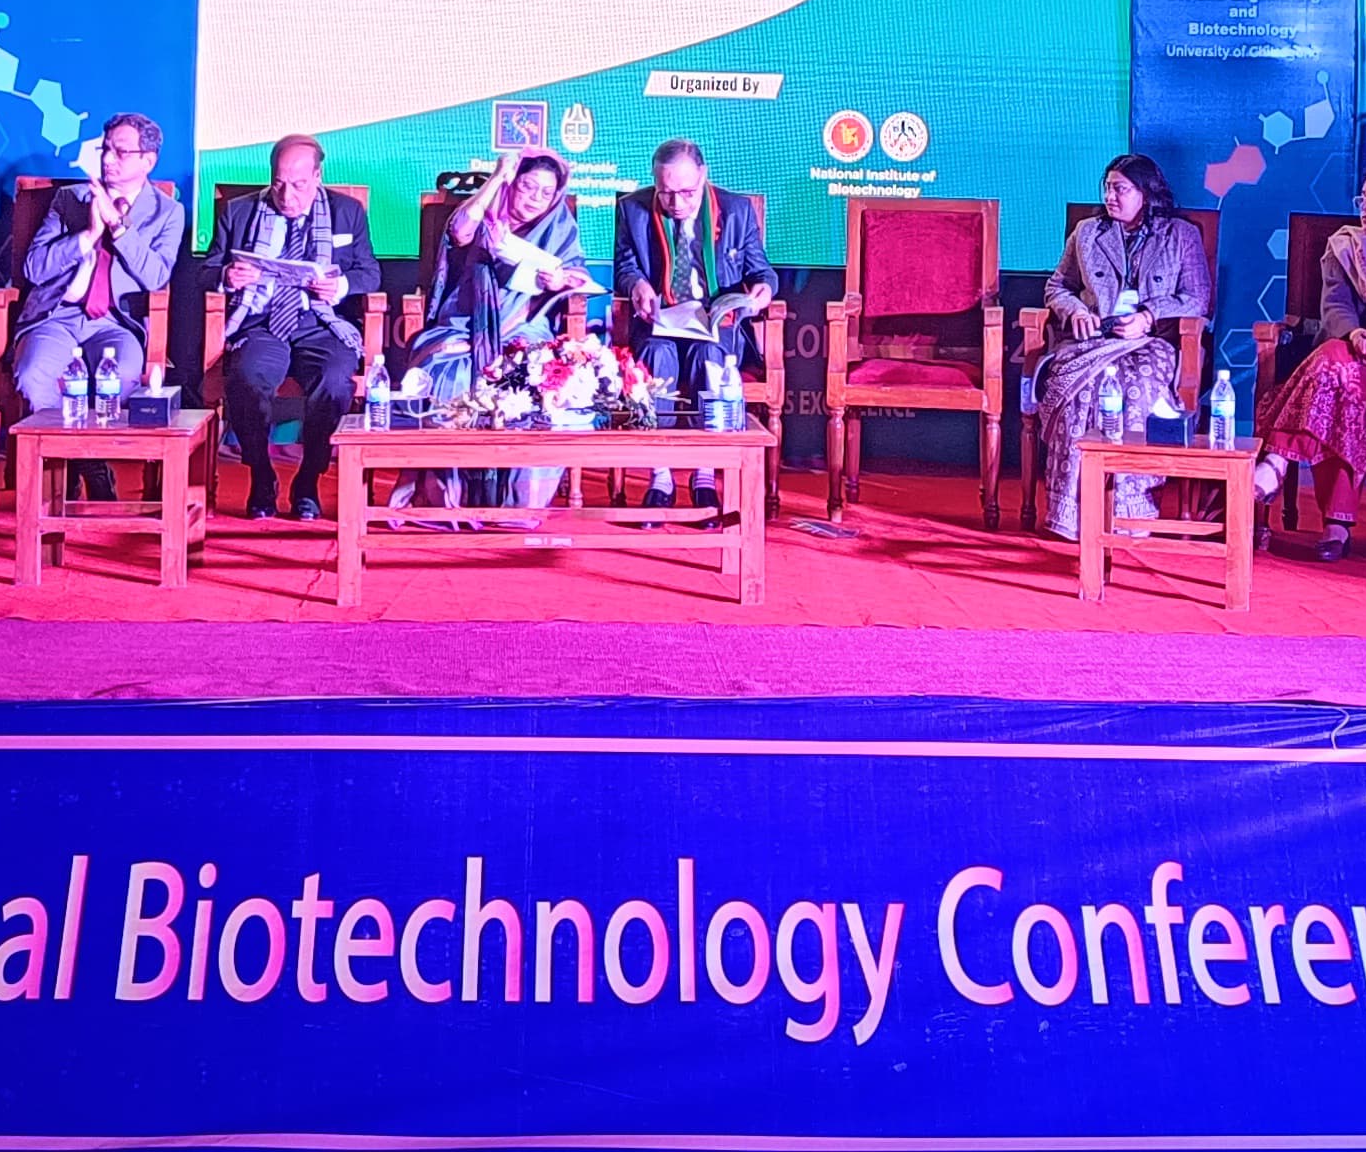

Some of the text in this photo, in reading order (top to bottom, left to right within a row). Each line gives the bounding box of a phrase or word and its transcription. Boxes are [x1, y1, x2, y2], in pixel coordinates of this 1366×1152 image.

[1229, 5, 1258, 19] and
[1188, 22, 1299, 38] Biotechnology
[1166, 43, 1229, 59] University
[1232, 44, 1247, 58] of
[670, 74, 760, 95] Organized By
[810, 168, 937, 182] National Institute of
[827, 182, 921, 199] Biotechnology
[115, 856, 905, 1047] Biotechnology
